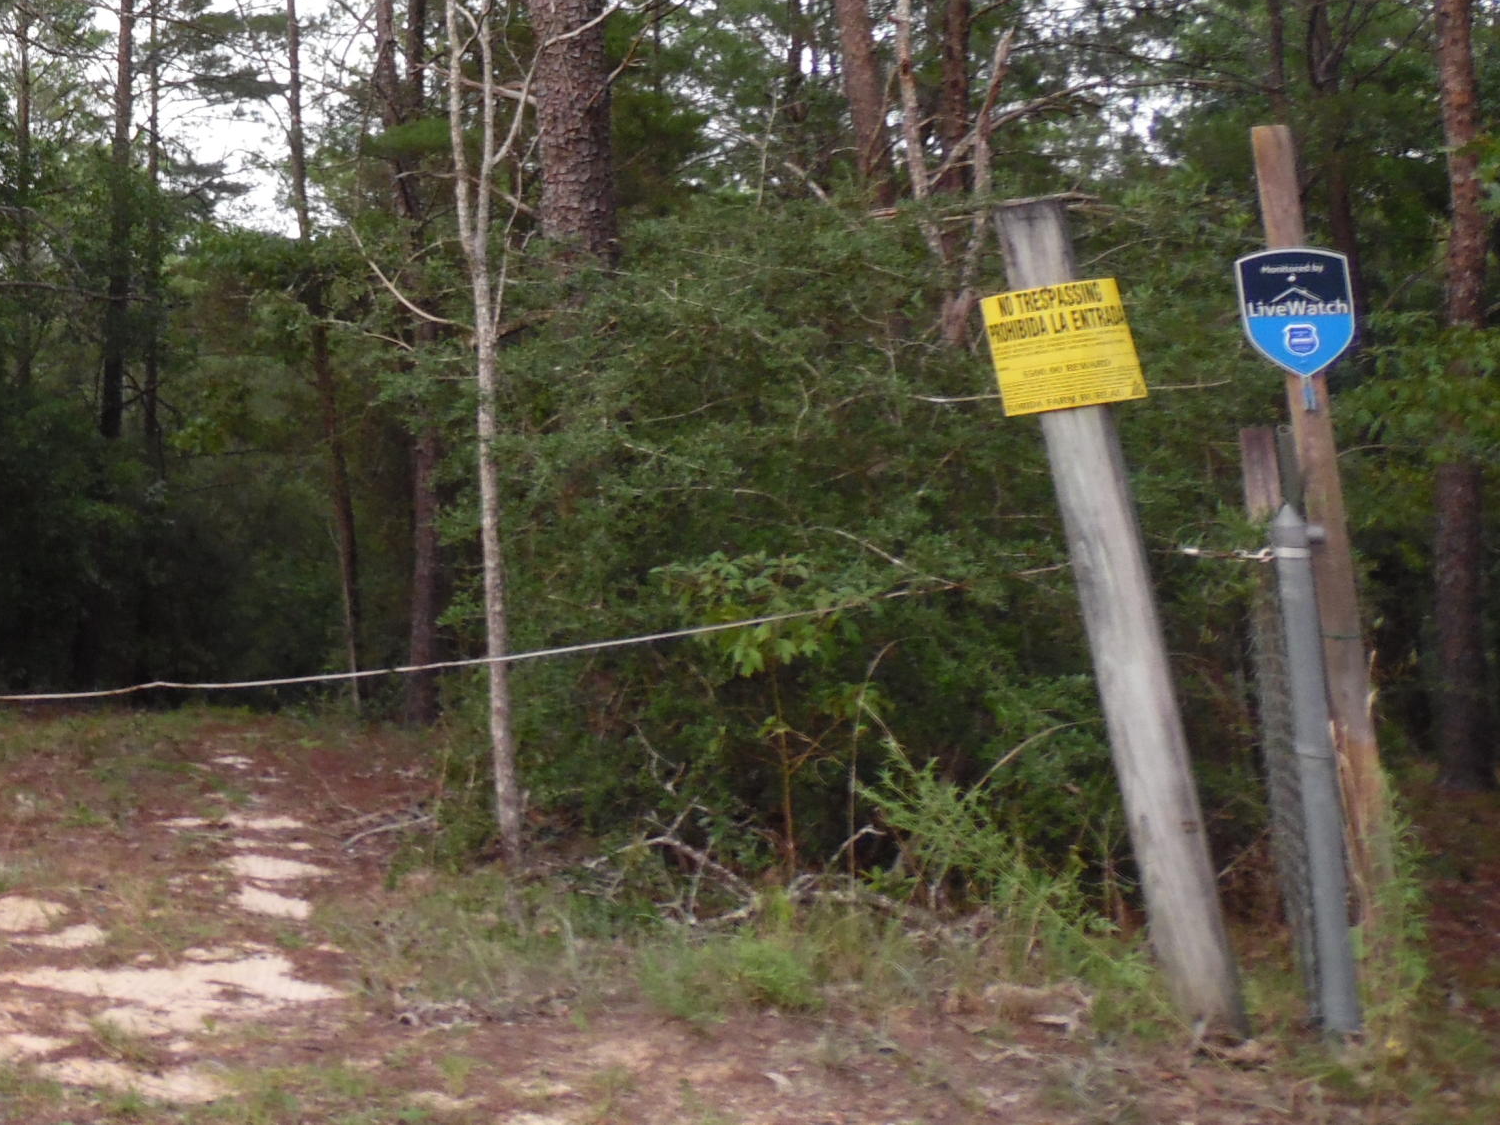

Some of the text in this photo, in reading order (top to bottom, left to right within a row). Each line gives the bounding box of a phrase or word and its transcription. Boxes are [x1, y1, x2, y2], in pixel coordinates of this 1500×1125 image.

[1260, 263, 1324, 274] Monitored by
[998, 281, 1103, 316] NO TRESPASSING
[1247, 297, 1349, 317] LiveWatch
[988, 316, 1049, 344] PROHIBIDA
[1051, 312, 1069, 334] LA
[1070, 305, 1125, 330] ENTRADA
